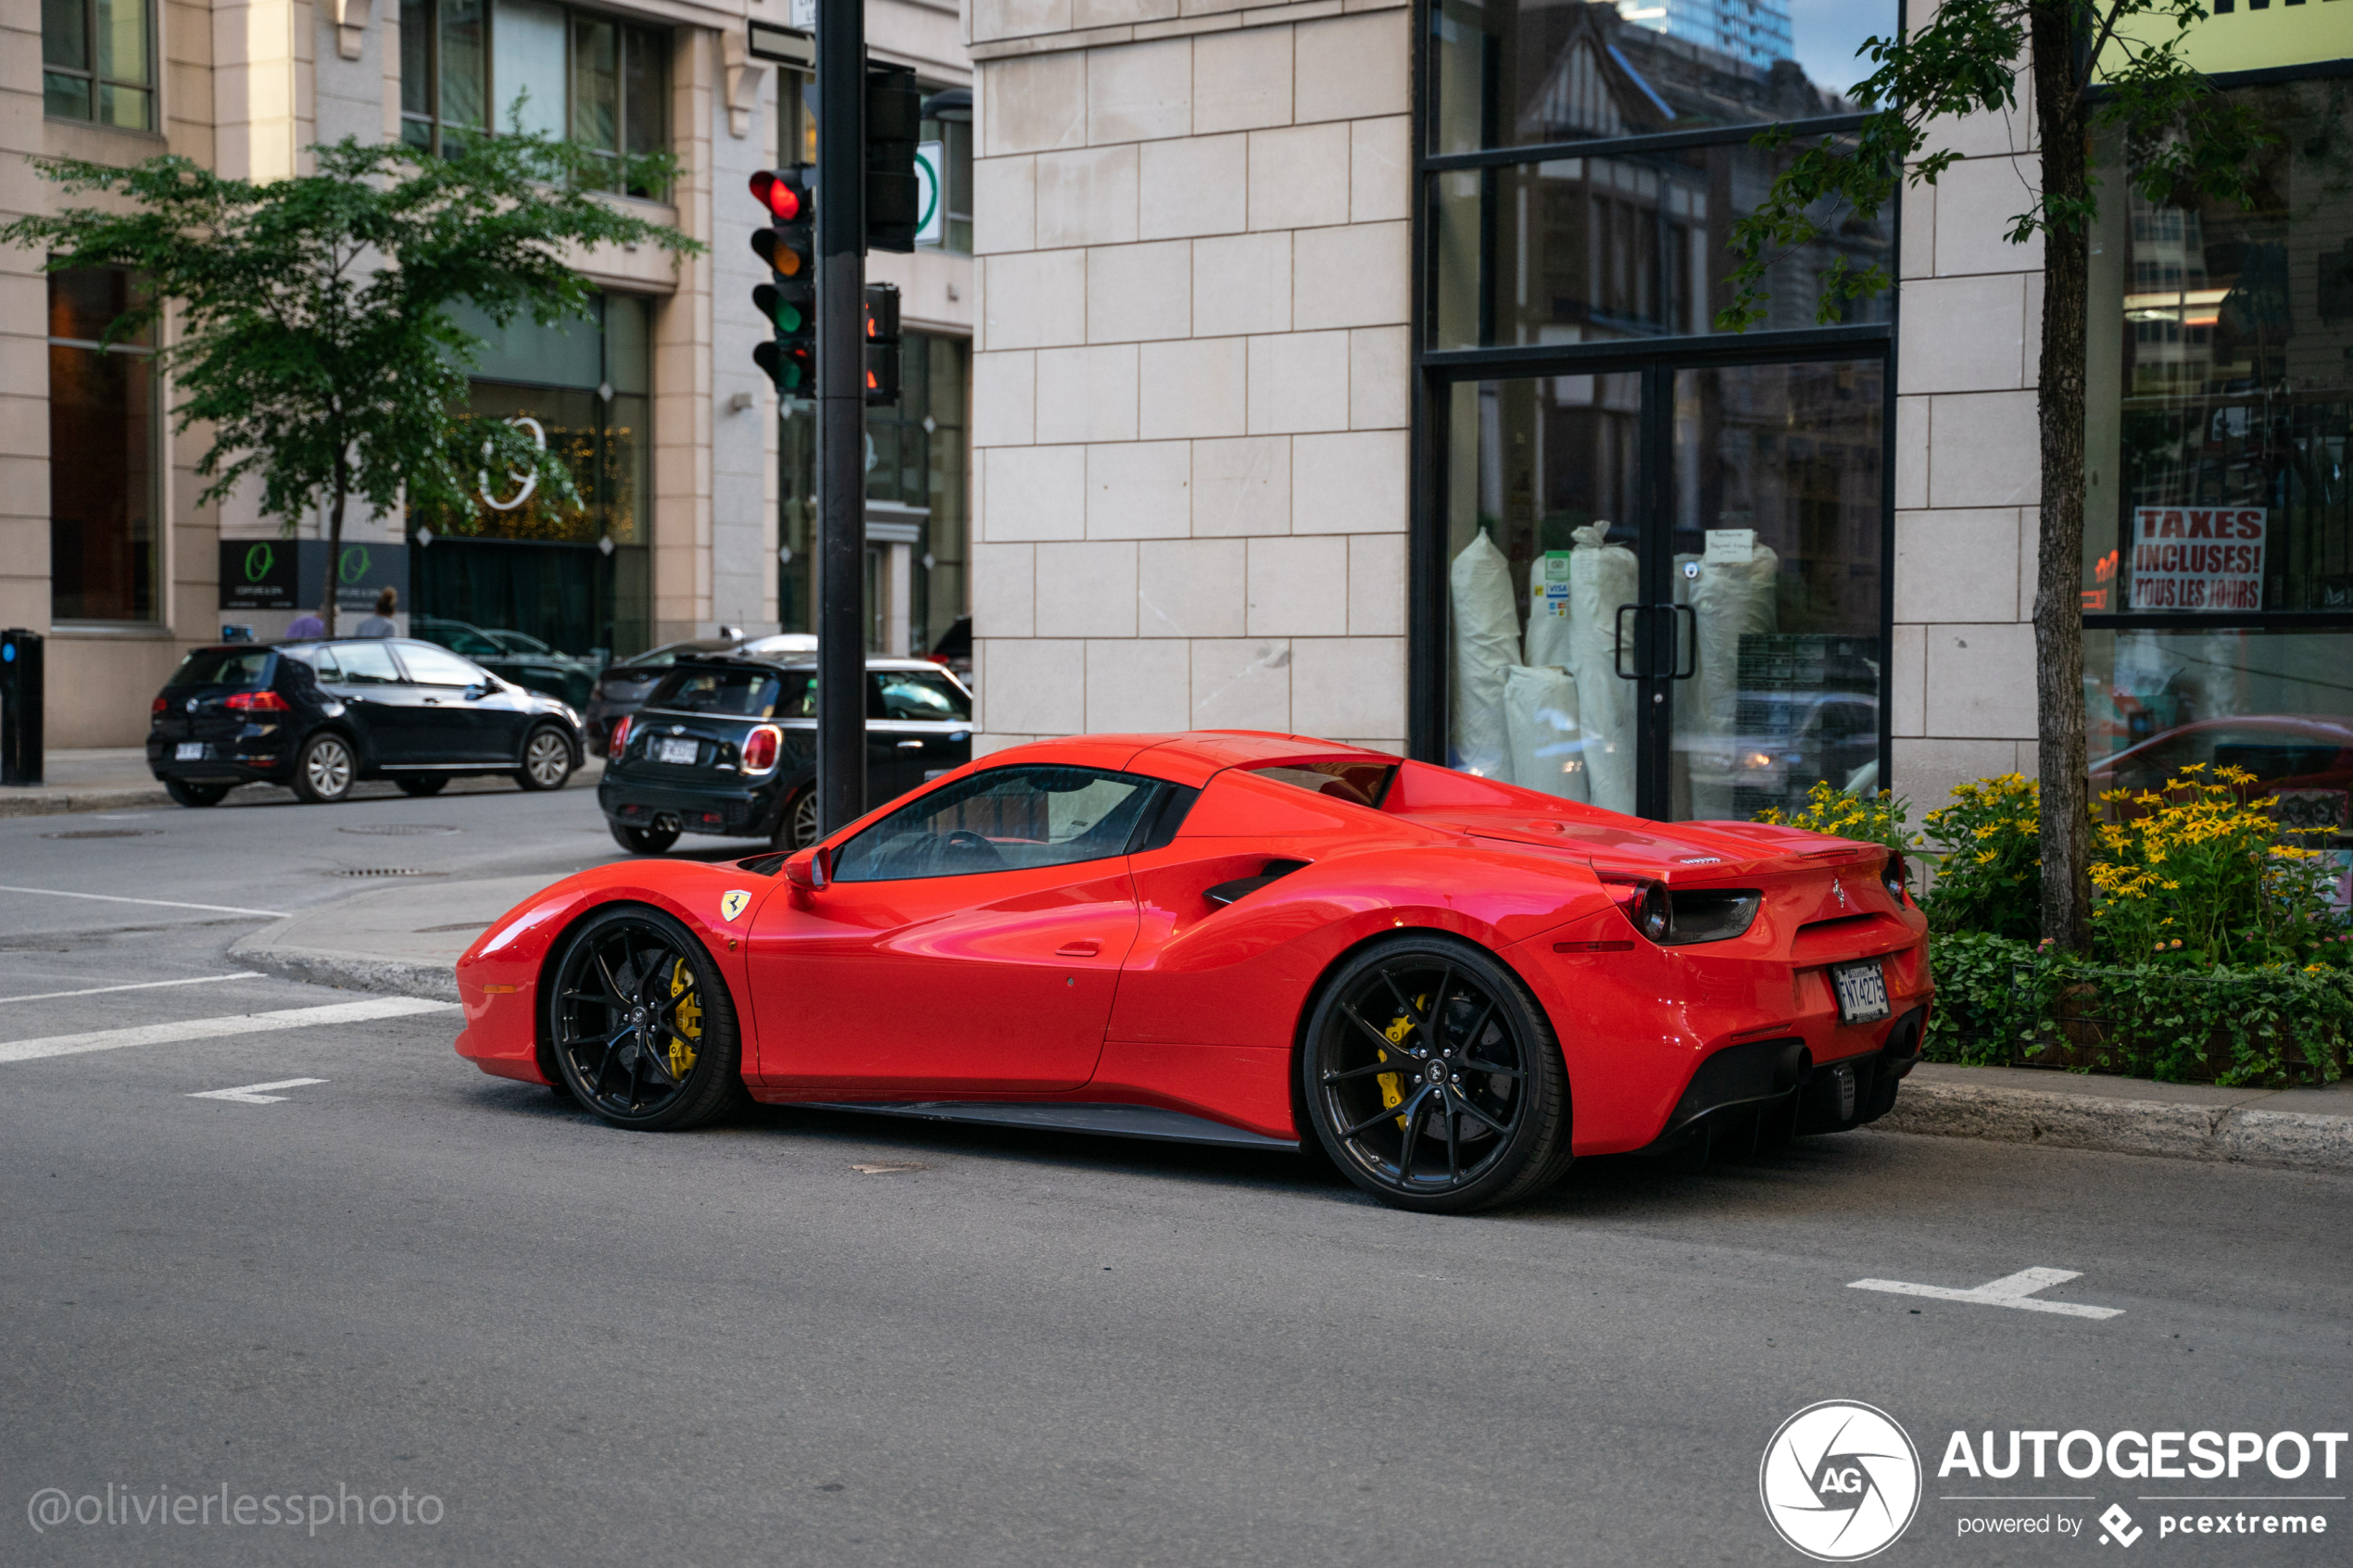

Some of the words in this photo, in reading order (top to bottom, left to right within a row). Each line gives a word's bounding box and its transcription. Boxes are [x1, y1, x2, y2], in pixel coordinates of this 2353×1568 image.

[2138, 511, 2261, 540] TAXES
[2136, 545, 2261, 573] INCLUSES!
[2135, 578, 2175, 607] TOUS
[2179, 579, 2205, 607] LES
[2208, 579, 2259, 608] JOURS
[1839, 975, 1885, 1010] FNT4275
